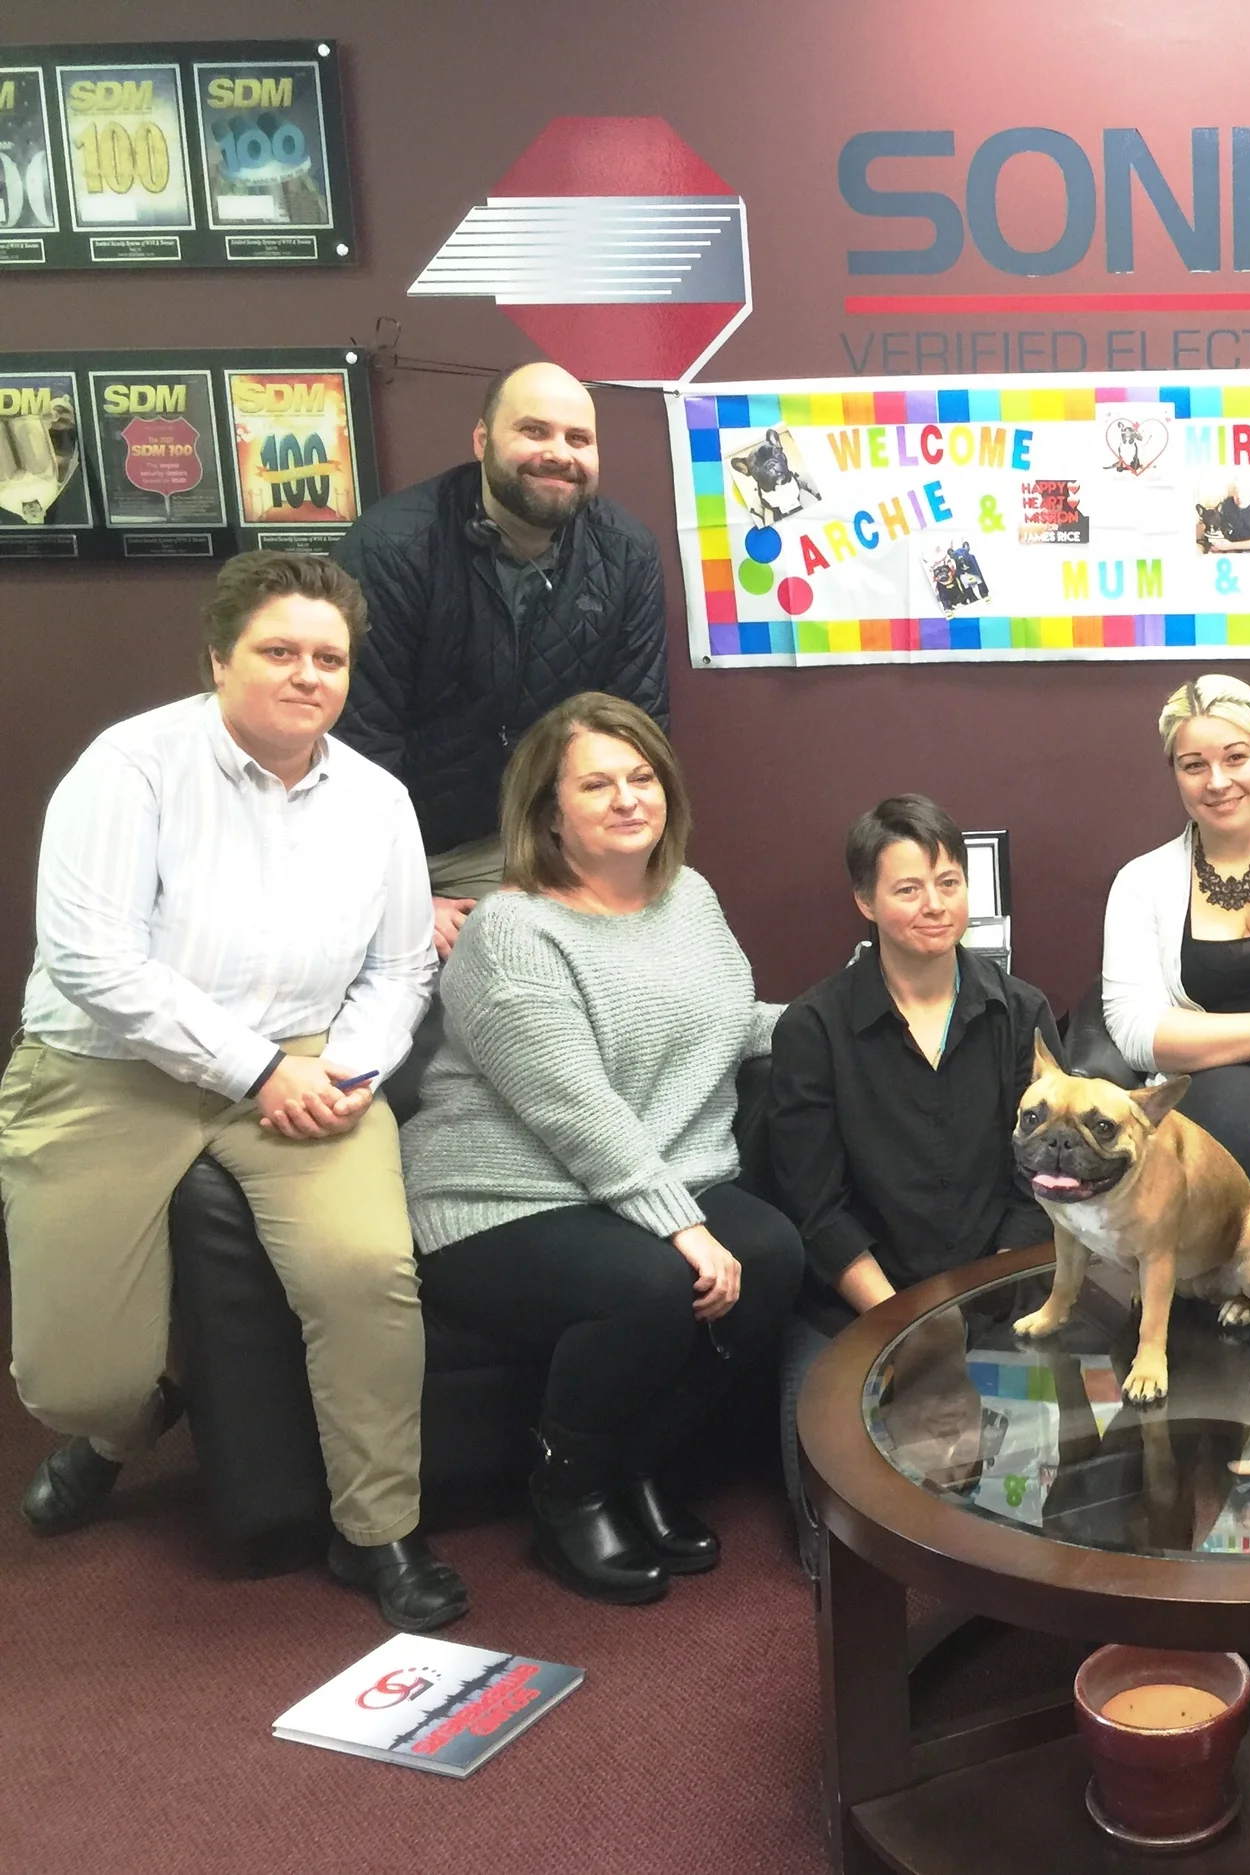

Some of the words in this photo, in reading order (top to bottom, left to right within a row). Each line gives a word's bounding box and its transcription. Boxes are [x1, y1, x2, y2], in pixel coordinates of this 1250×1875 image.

[70, 80, 153, 112] SDM
[207, 77, 293, 109] SDM
[72, 122, 170, 194] 100
[213, 113, 306, 174] 100
[839, 330, 1088, 376] VERIFIED
[0, 387, 52, 416] DM
[103, 384, 187, 414] SDM
[235, 381, 325, 413] SDM
[131, 444, 166, 457] SDM
[169, 444, 193, 457] 100
[827, 424, 1033, 472] WELCOME
[259, 432, 330, 509] 100
[1021, 482, 1066, 495] HAPPY
[1023, 495, 1066, 510] HEART
[799, 480, 953, 576] ARCHIE
[977, 494, 1006, 533] &
[1025, 511, 1079, 524] MISSION
[1024, 531, 1055, 543] JAMES
[1058, 531, 1081, 542] RICE
[1062, 558, 1163, 600] MUM
[1215, 558, 1241, 596] &
